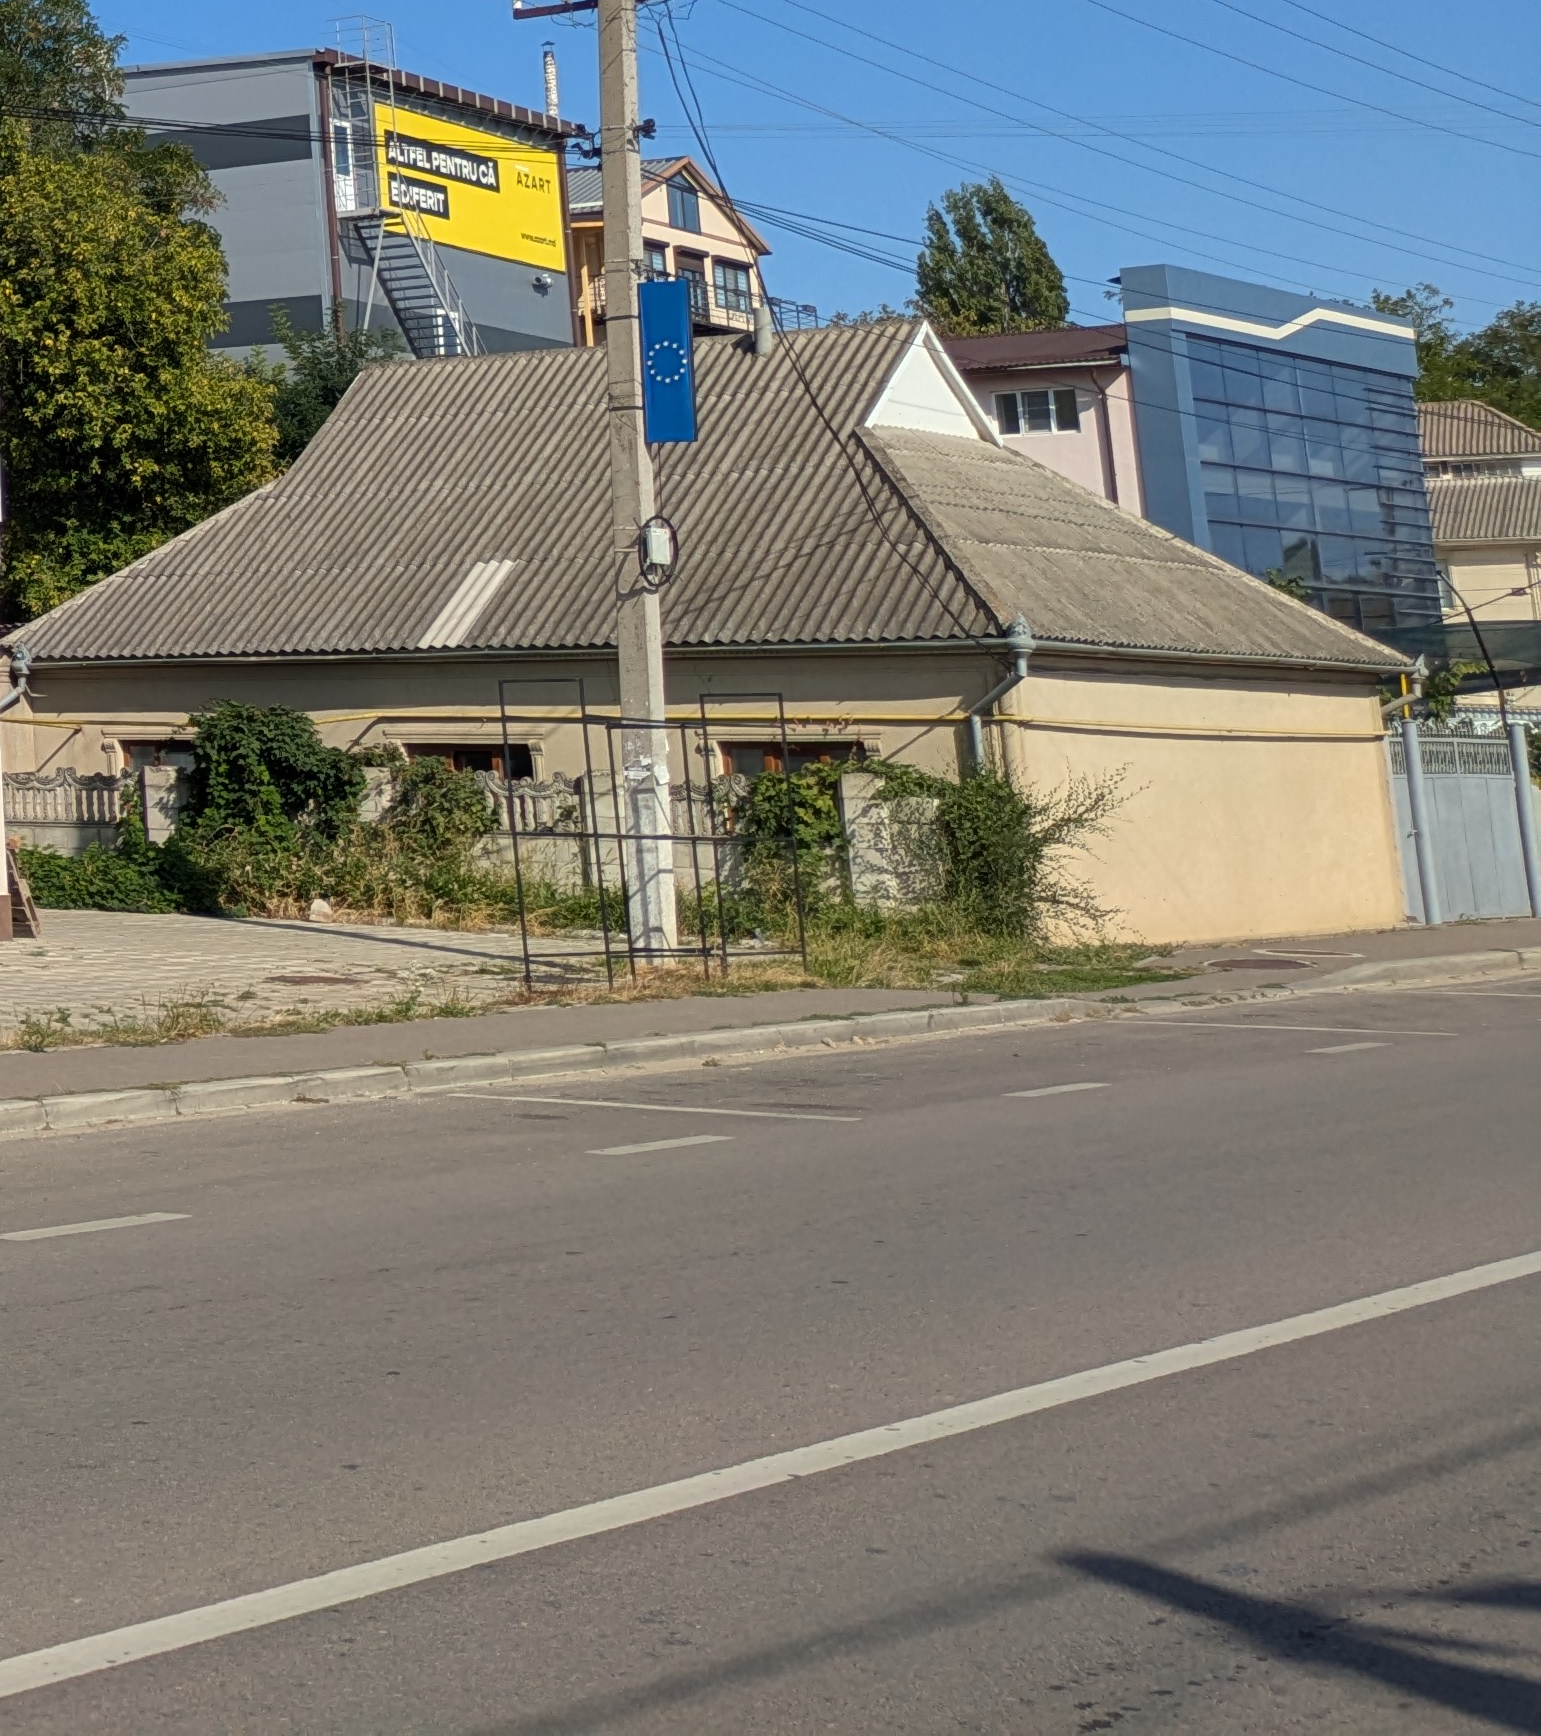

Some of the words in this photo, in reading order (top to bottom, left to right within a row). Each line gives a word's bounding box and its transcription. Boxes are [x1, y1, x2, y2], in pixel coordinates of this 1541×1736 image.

[388, 141, 431, 169] ALTFEL
[431, 151, 477, 182] PENTRU
[479, 161, 497, 187] CĂ
[516, 171, 551, 194] AZART
